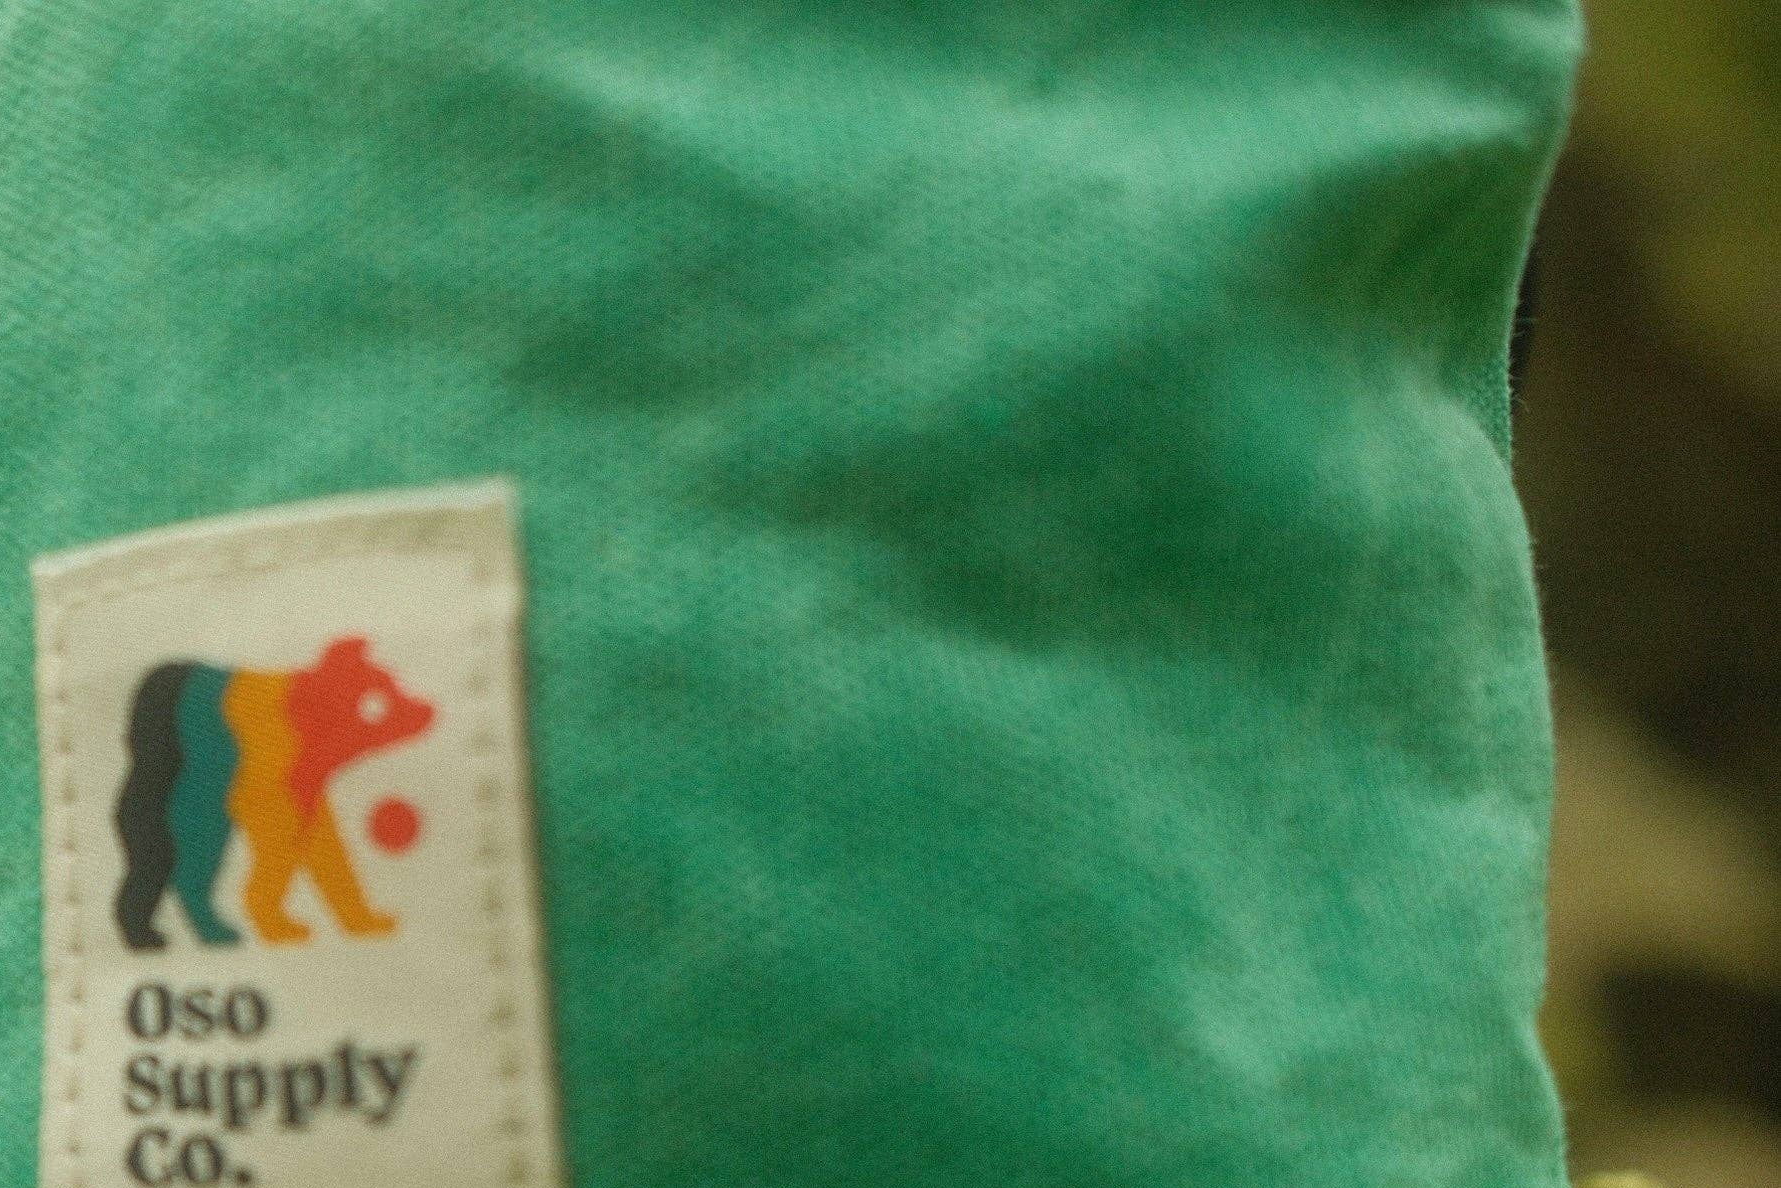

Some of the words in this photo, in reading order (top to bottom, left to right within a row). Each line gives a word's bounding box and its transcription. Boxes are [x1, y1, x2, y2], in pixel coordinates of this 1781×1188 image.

[125, 981, 269, 1040] Oso
[123, 1039, 419, 1130] Supply
[124, 1127, 254, 1187] Co.
